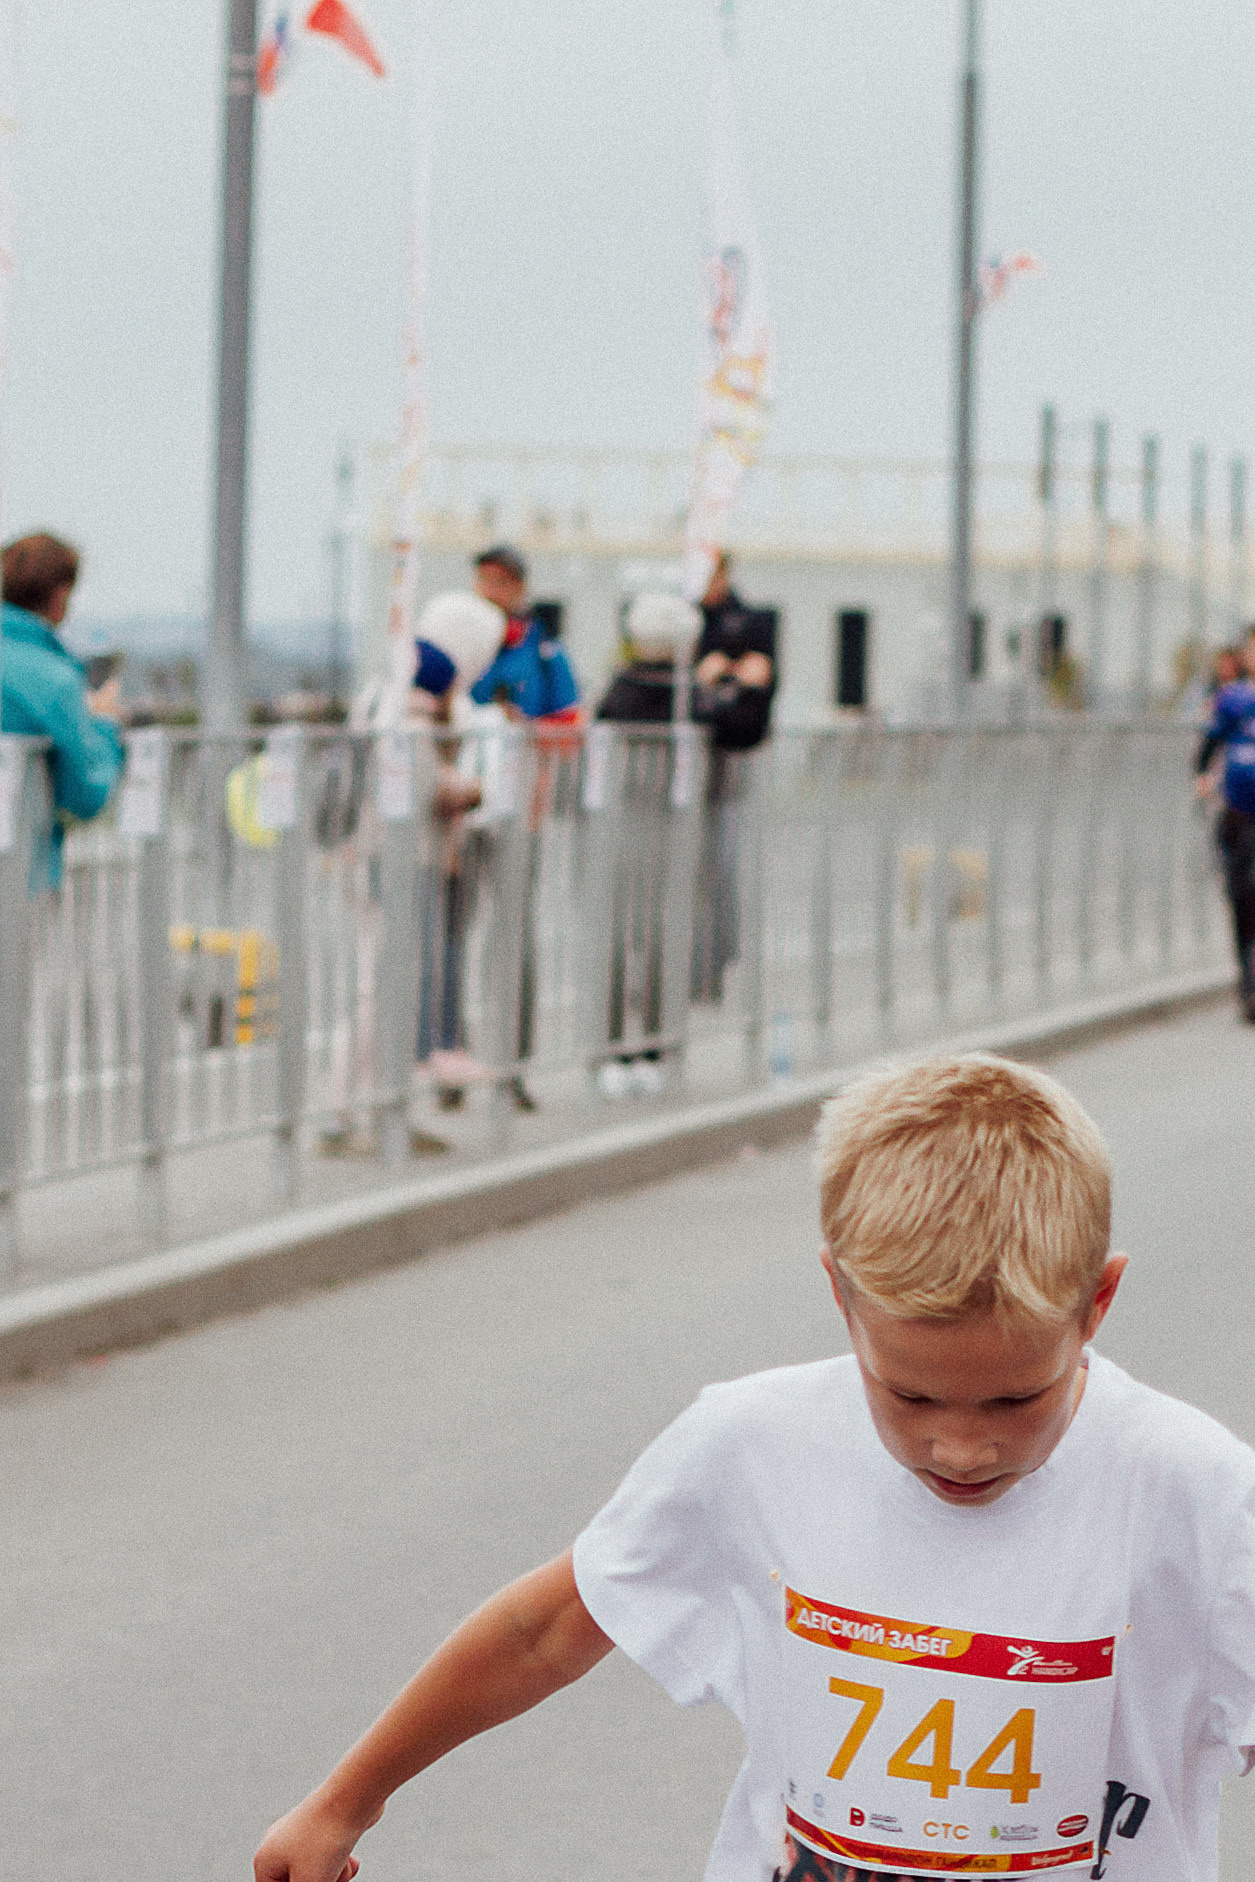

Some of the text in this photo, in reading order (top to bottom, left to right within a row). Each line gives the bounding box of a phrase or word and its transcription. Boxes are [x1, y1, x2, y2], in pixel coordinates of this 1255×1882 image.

[797, 1607, 952, 1656] ДЕТСКИЙ ЗАБЕГ
[826, 1675, 1042, 1804] 744
